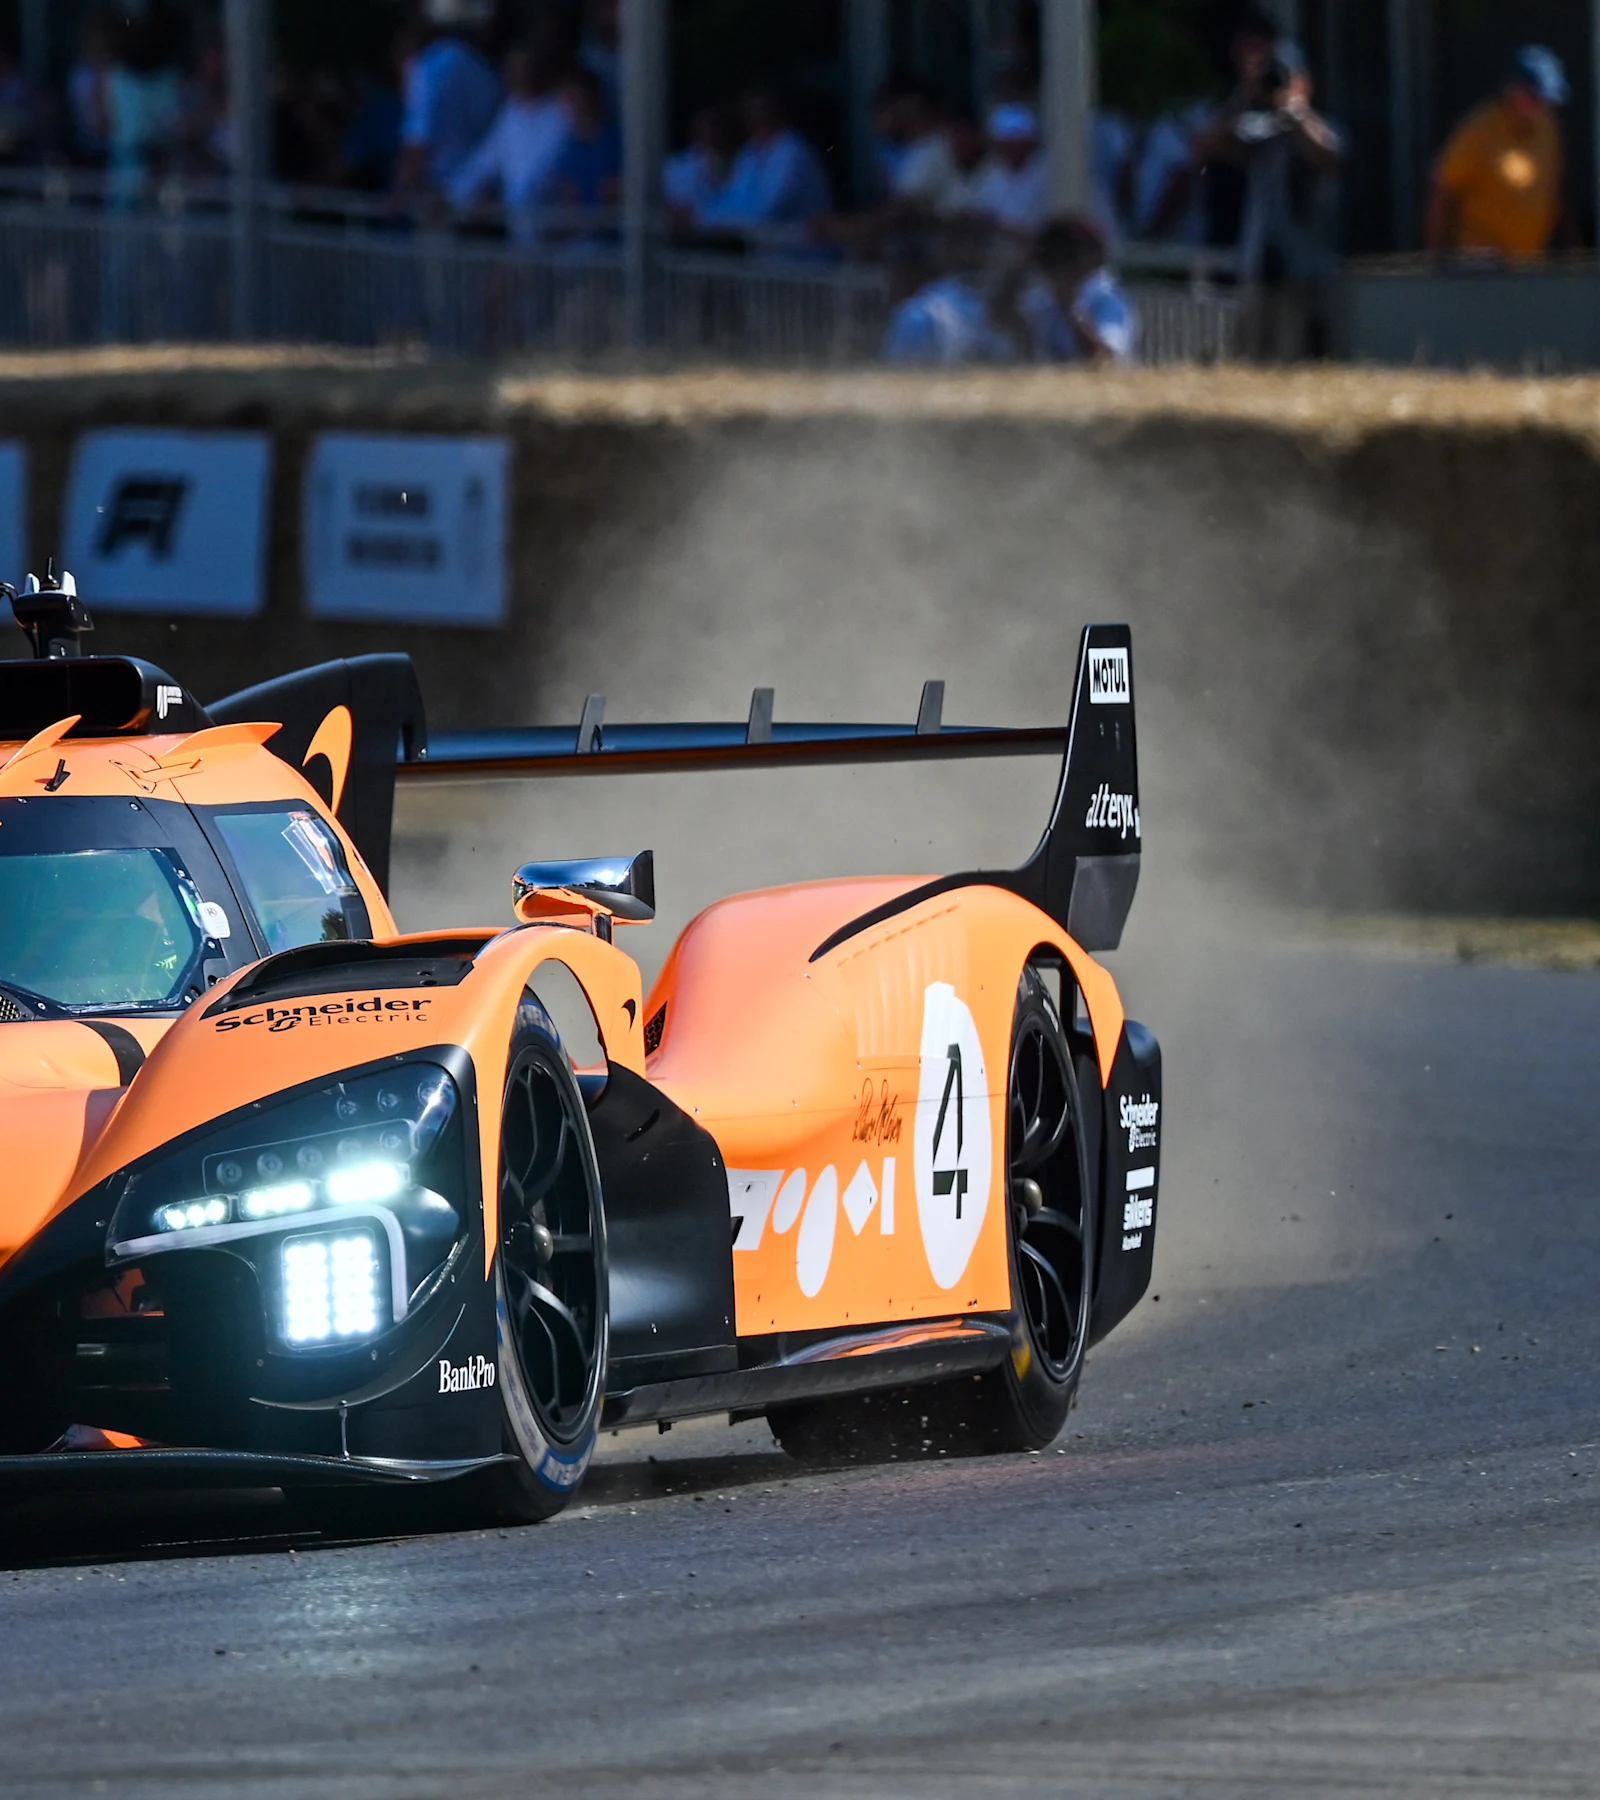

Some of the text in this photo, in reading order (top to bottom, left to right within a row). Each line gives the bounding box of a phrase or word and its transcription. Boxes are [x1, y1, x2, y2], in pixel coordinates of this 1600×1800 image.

[1093, 658, 1126, 693] MOTUL
[1085, 782, 1134, 840] alteryx
[215, 997, 432, 1032] Schneider
[309, 1012, 428, 1026] Electric
[1119, 1092, 1159, 1129] Schneider
[932, 1043, 968, 1219] 4
[438, 1355, 495, 1393] BankPro
